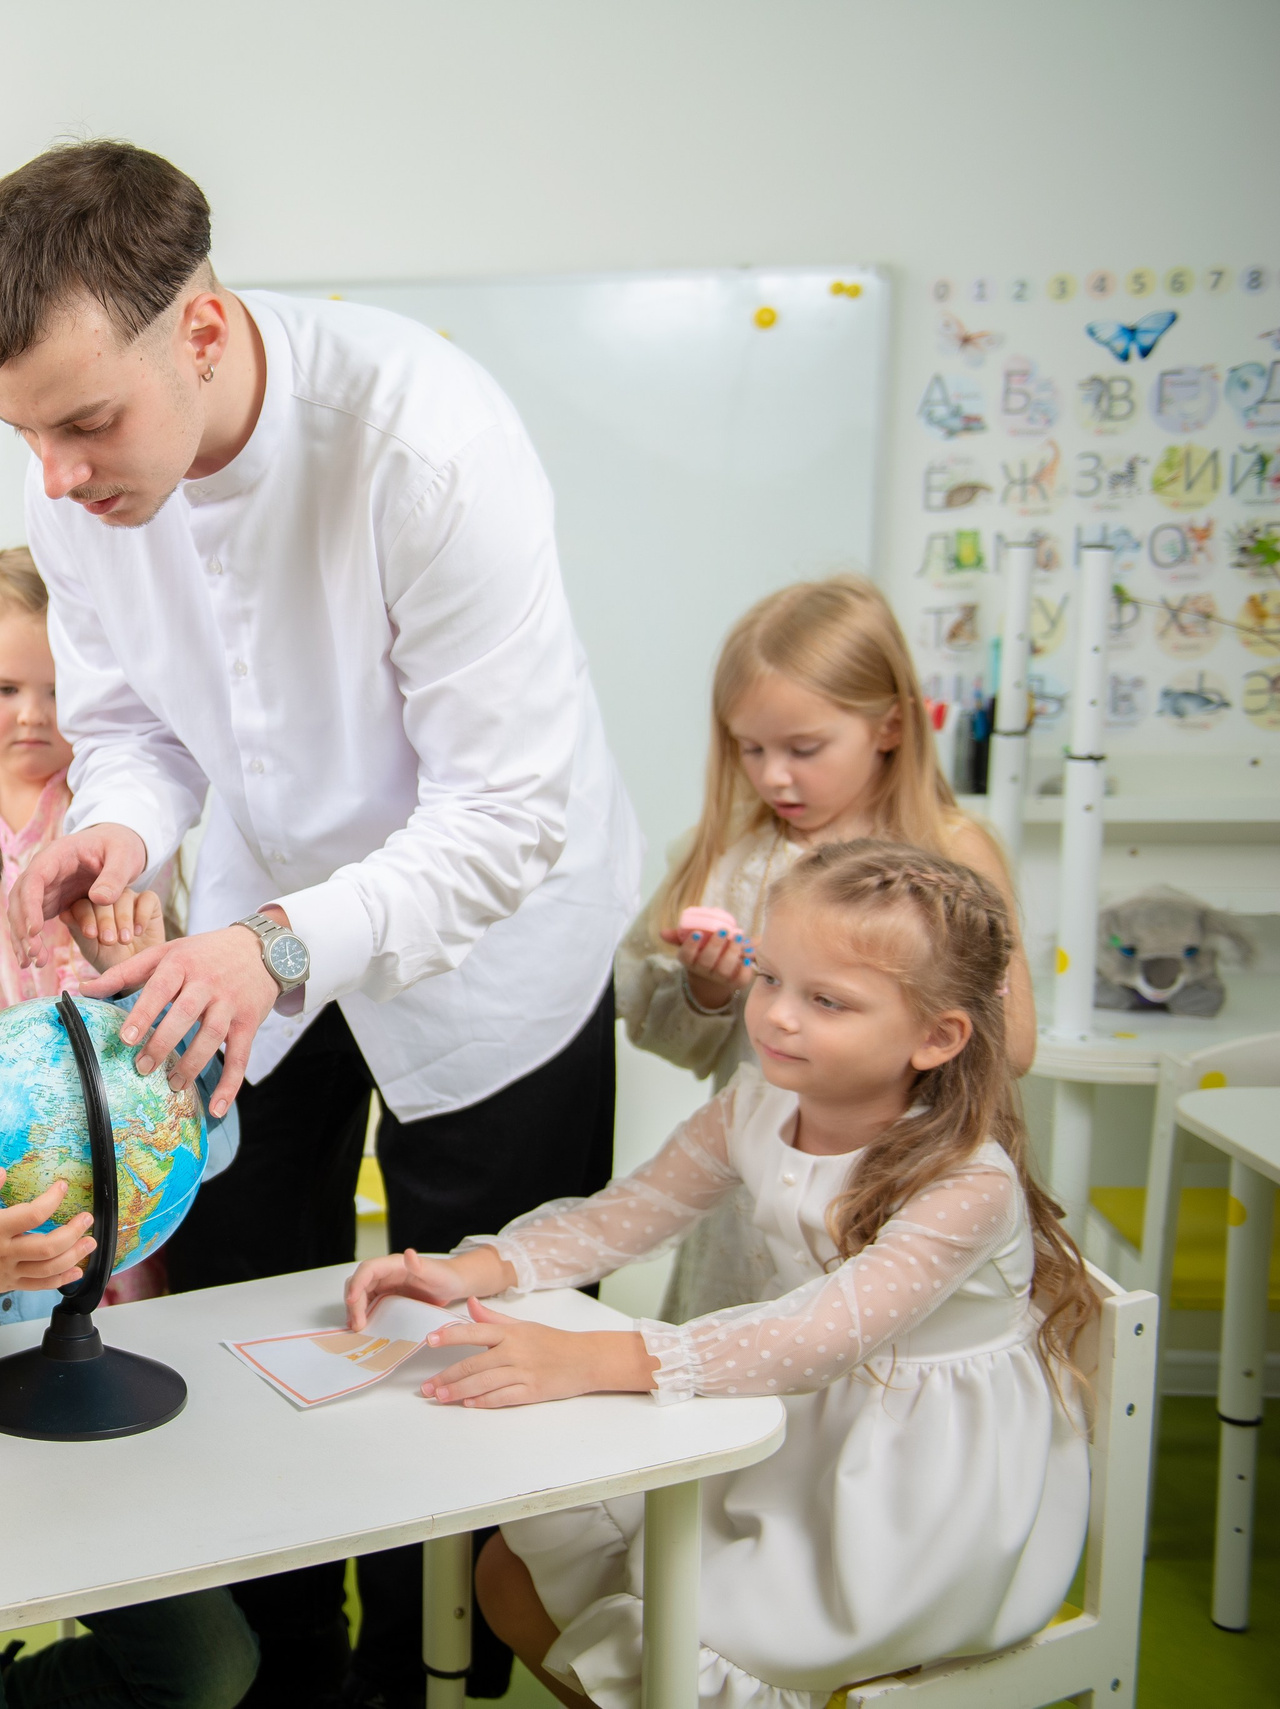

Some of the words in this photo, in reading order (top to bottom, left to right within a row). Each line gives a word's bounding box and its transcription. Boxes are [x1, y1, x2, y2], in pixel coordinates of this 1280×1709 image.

[974, 280, 987, 301] 1
[1014, 280, 1027, 301] 2
[1055, 278, 1067, 299] 3
[1093, 276, 1108, 294] 4
[1132, 273, 1146, 294] 5
[1171, 273, 1186, 292] 6
[1209, 271, 1224, 291] 7
[1247, 270, 1263, 290] 8
[1002, 369, 1032, 415] Б
[1157, 368, 1186, 416] Г
[1000, 458, 1049, 504] Ж
[1184, 446, 1221, 493] И
[1229, 443, 1265, 496] Й
[1148, 522, 1190, 570] О
